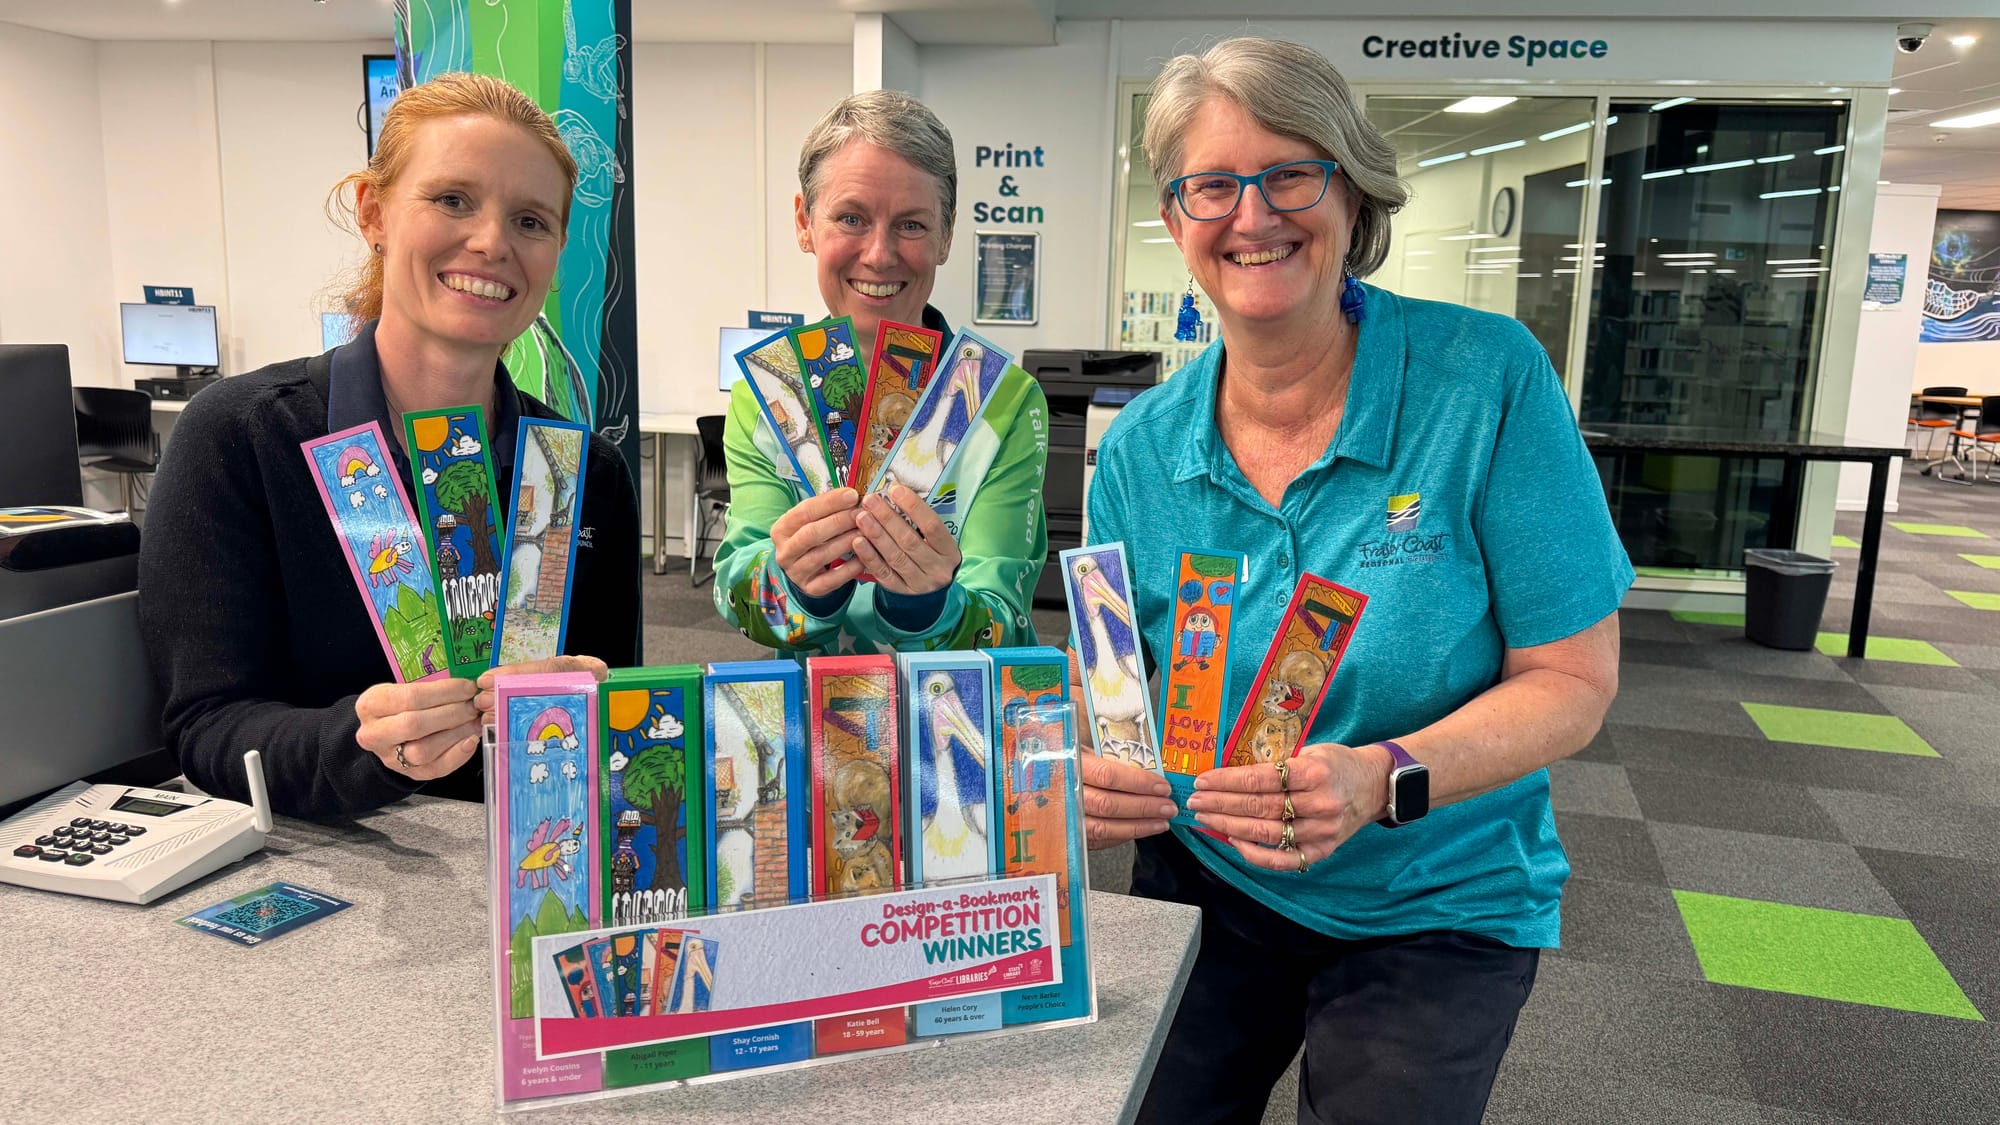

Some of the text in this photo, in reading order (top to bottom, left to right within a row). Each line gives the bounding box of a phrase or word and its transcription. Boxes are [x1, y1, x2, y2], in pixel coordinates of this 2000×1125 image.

[1362, 32, 1608, 66] Creative Space
[975, 143, 1044, 167] Print
[999, 175, 1020, 197] &
[974, 202, 1044, 223] Scan
[1028, 407, 1046, 453] talk
[1359, 532, 1451, 560] Fraser Coast
[1170, 684, 1195, 711] I
[1010, 829, 1036, 863] I
[883, 886, 1040, 919] Design-a-Bookmark
[860, 902, 1040, 947] COMPETITION
[923, 928, 1043, 965] WINNERS
[955, 972, 988, 985] LIBRARIES
[941, 1003, 978, 1013] Helen Cory
[1045, 1000, 1066, 1009] Choice
[847, 1018, 880, 1028] Katie Bell
[943, 1015, 962, 1025] years
[732, 1033, 780, 1047] Shay Cornish
[843, 1030, 851, 1038] 18
[856, 1029, 865, 1037] 59
[865, 1027, 885, 1038] years
[749, 1046, 757, 1054] 17
[758, 1044, 779, 1055] years
[522, 1062, 581, 1076] Evelyn Cousins
[654, 1059, 675, 1071] years
[521, 1078, 527, 1086] 6
[527, 1075, 550, 1087] years
[558, 1072, 582, 1083] under
